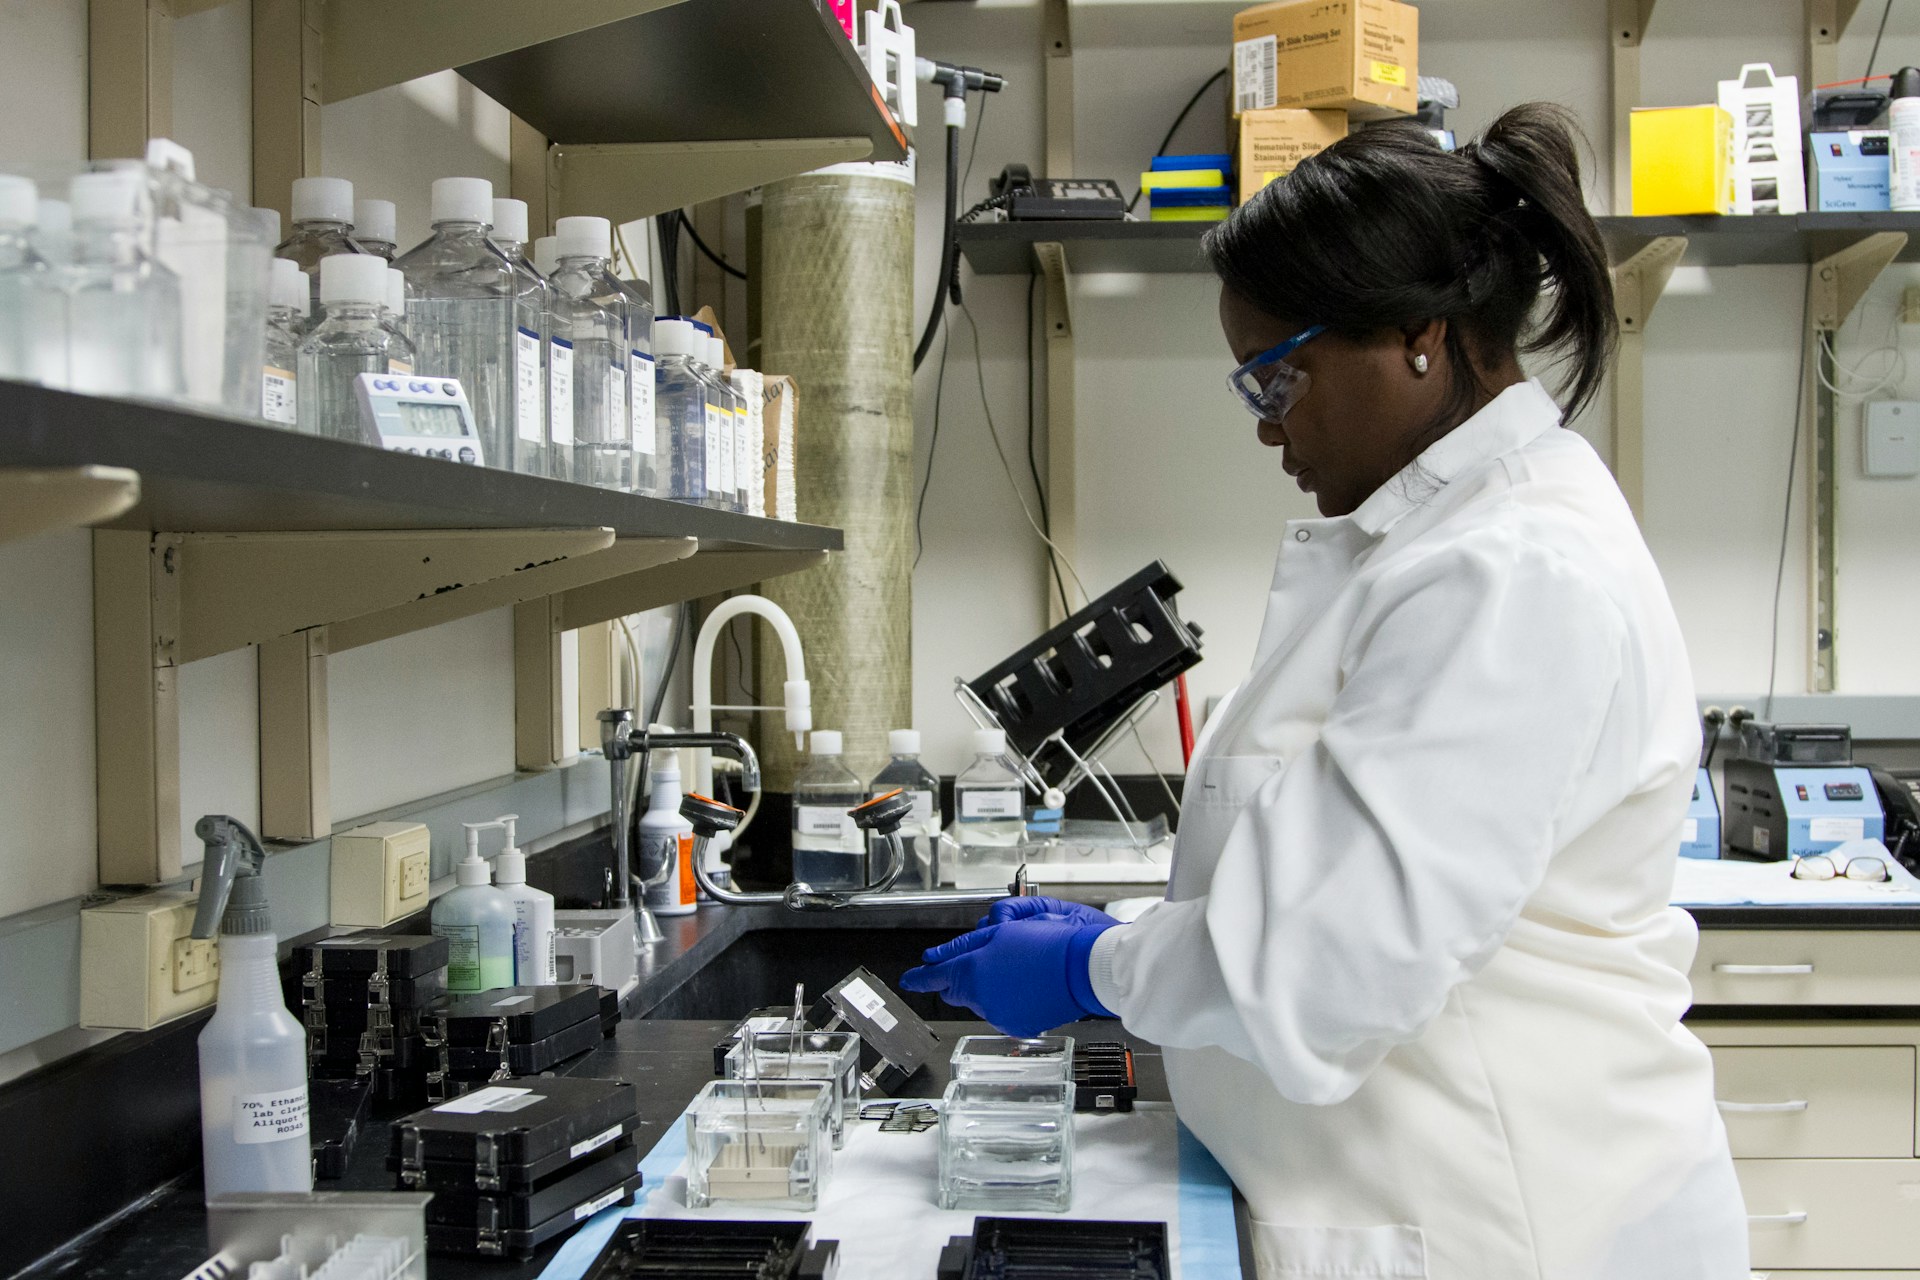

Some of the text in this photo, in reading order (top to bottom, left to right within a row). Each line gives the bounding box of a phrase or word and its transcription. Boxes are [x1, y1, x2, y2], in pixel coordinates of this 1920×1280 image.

[1303, 31, 1329, 43] Staining
[1330, 28, 1341, 37] Set
[1254, 141, 1322, 153] Hematology Slide
[1254, 153, 1287, 163] Staining
[1825, 200, 1857, 208] SciGene
[242, 1093, 306, 1110] 70% Ethanol
[253, 1115, 298, 1127] Aliquot
